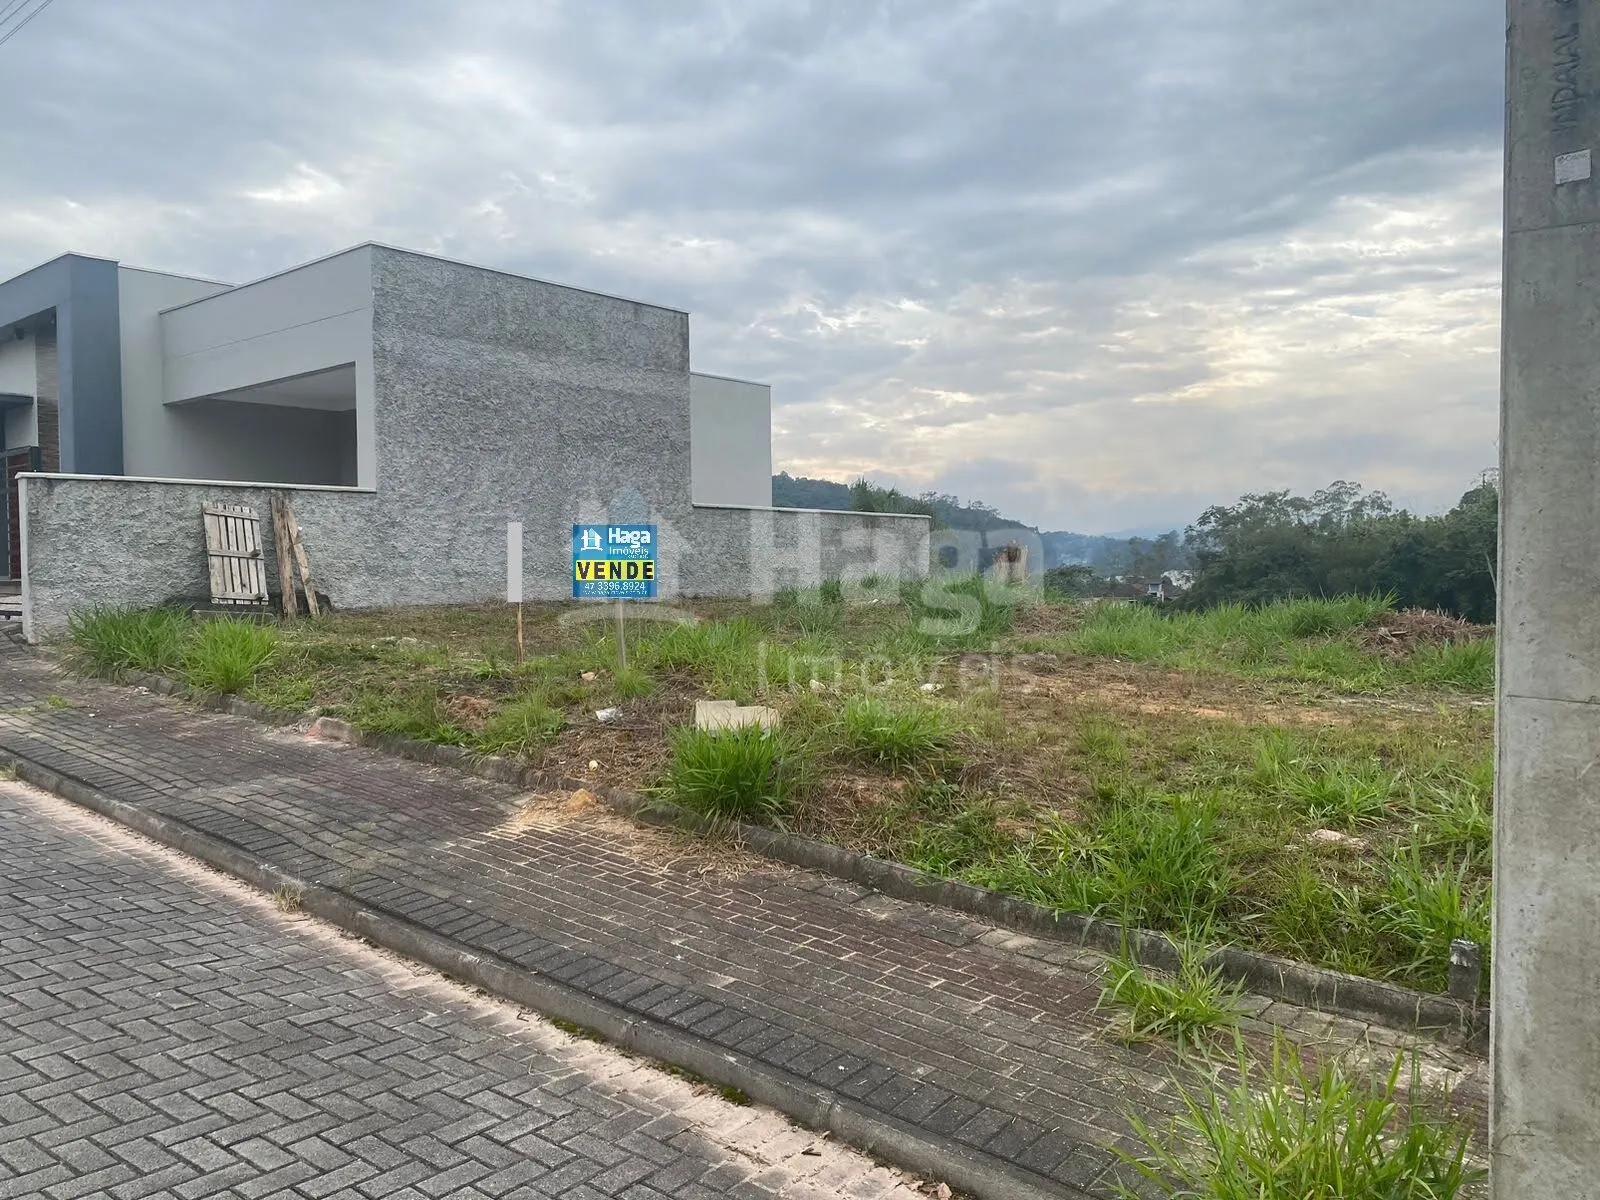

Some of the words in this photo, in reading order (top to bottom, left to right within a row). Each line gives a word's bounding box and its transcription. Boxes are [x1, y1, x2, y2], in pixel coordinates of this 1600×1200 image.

[608, 527, 651, 549] Haga
[609, 546, 649, 556] Imóveis
[576, 561, 654, 580] VENDE
[584, 582, 595, 591] 47
[597, 581, 646, 591] 3396.8924
